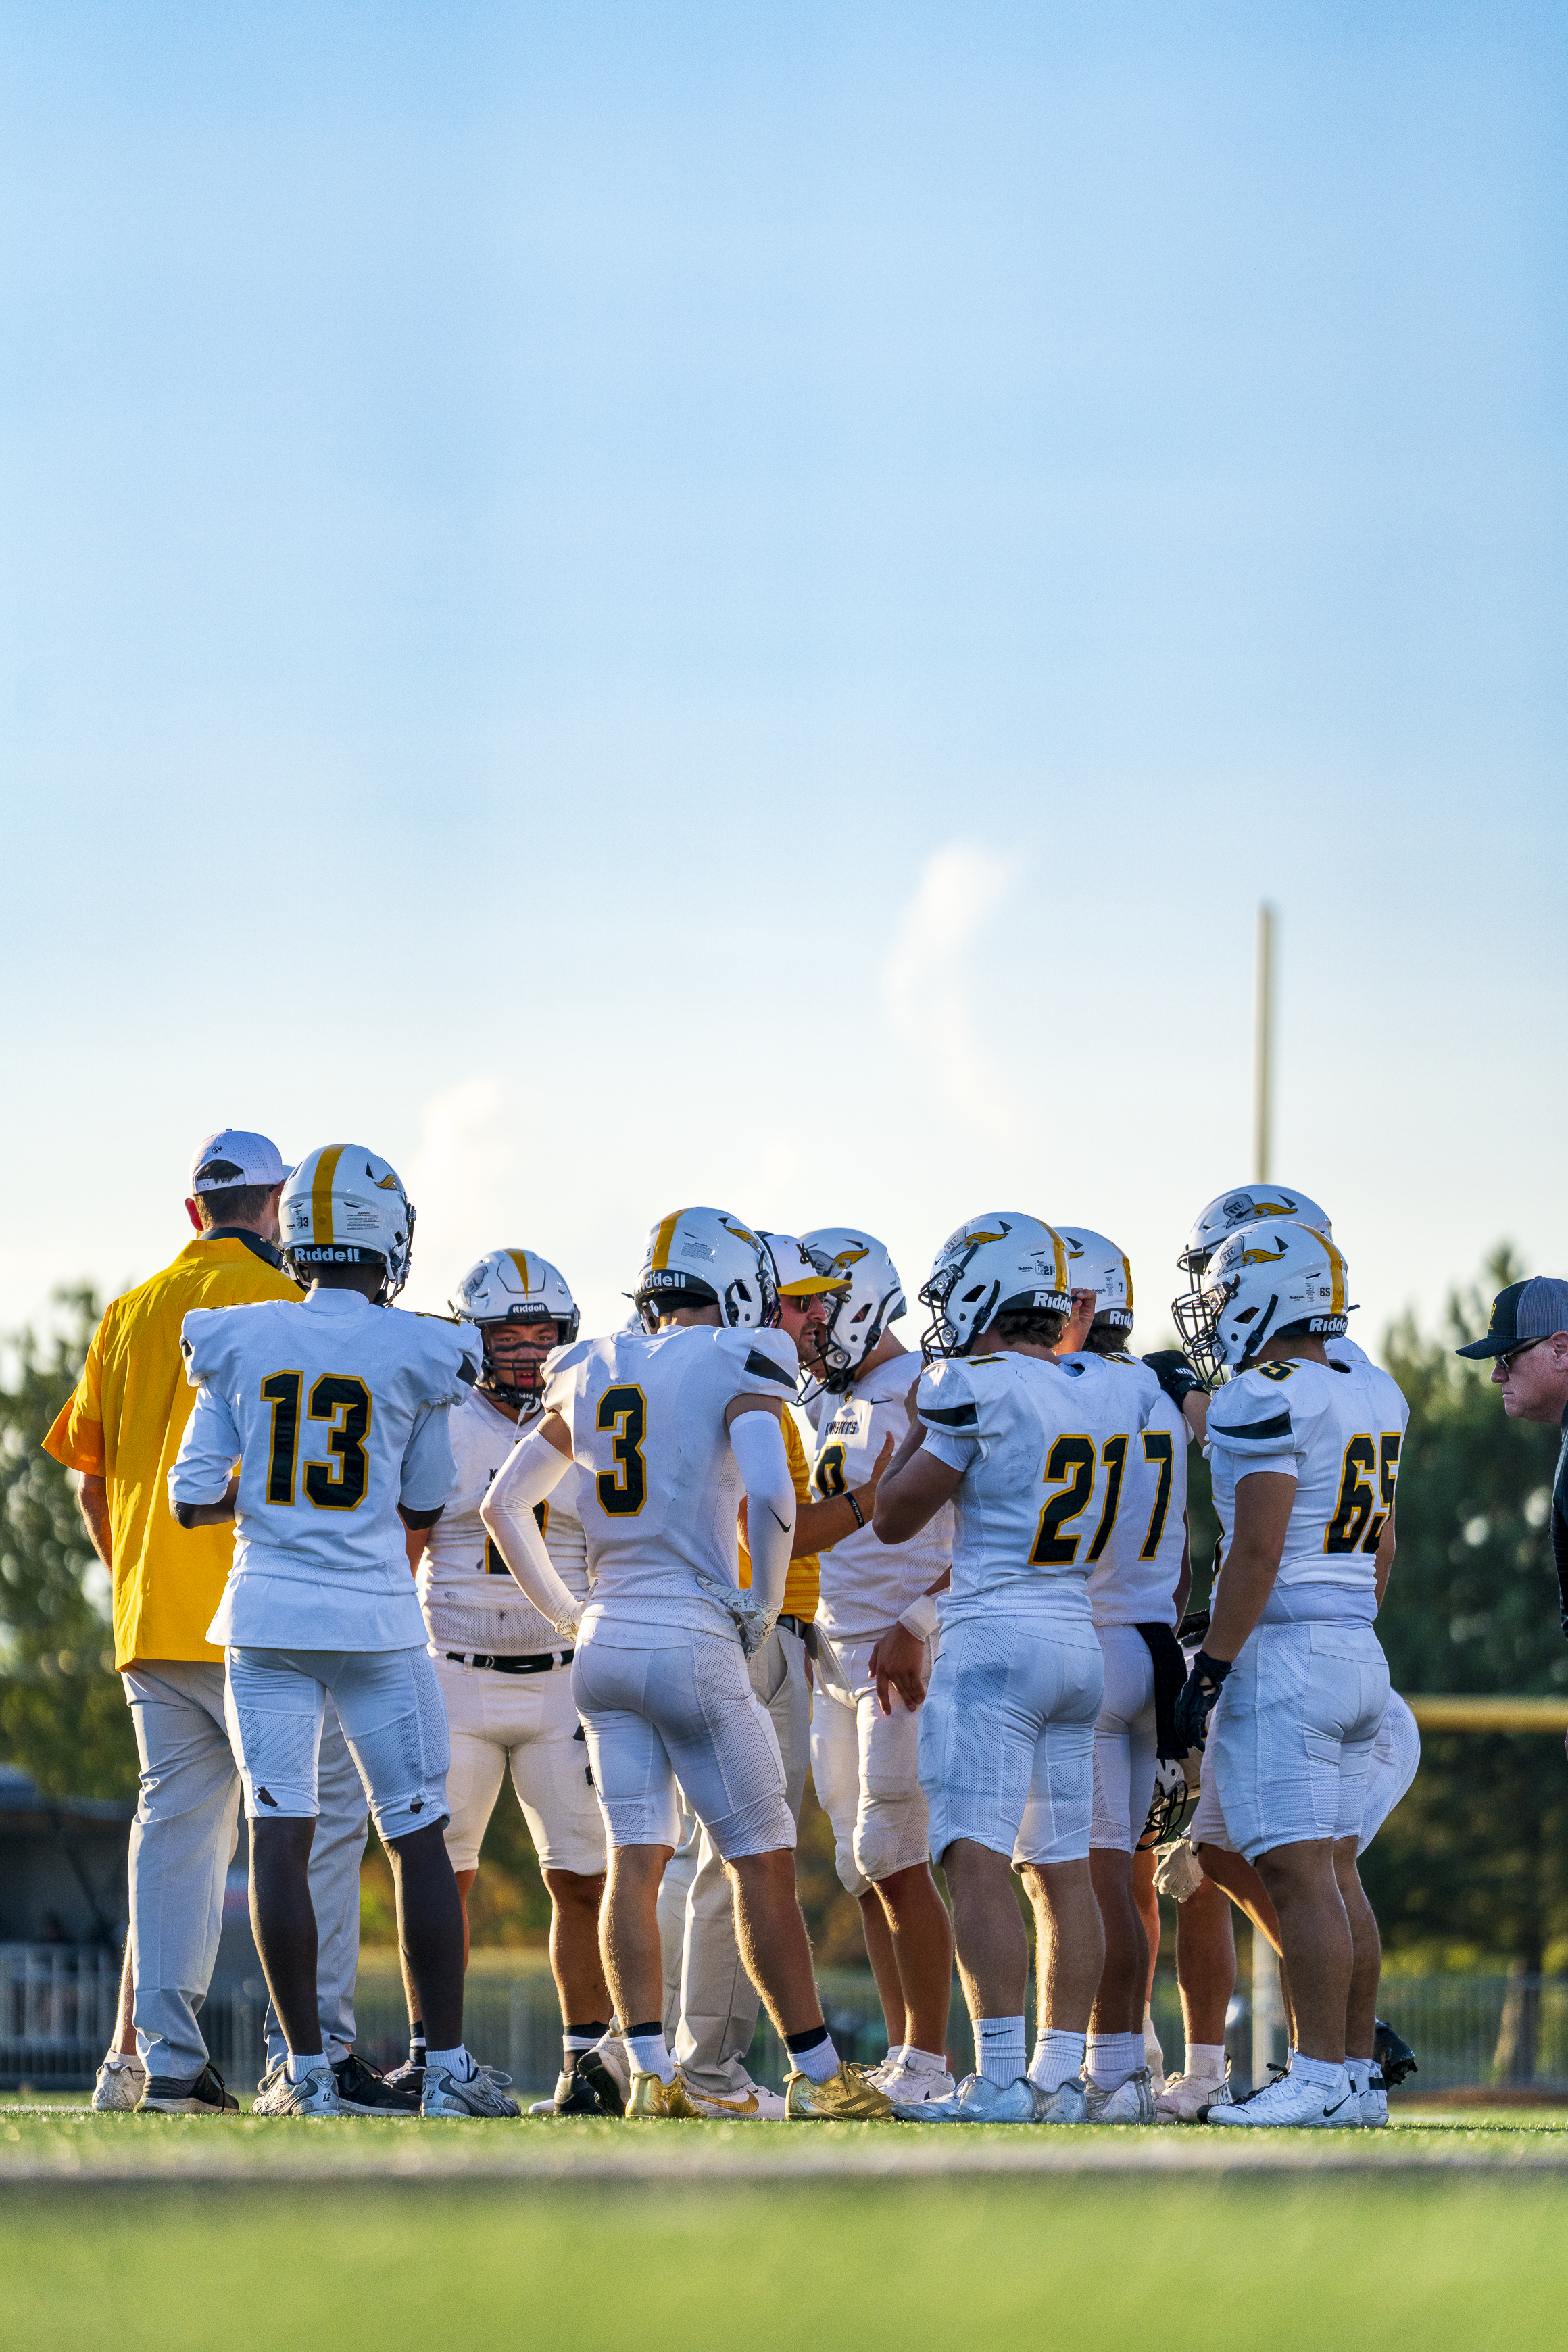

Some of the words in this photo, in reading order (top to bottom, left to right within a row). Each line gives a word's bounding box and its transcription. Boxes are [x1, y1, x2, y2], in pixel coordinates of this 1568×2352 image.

[300, 1217, 309, 1227] 13
[294, 1247, 360, 1263] Riddell
[1044, 1265, 1053, 1275] 21
[1118, 1282, 1124, 1292] 7
[1319, 1287, 1331, 1297] 65
[512, 1304, 545, 1313] Riddell
[1308, 1317, 1348, 1333] Ridde
[825, 1421, 858, 1436] KNIGHTS
[260, 1369, 373, 1512] 13
[595, 1383, 648, 1518] 3
[1027, 1433, 1130, 1567] 21
[1137, 1430, 1175, 1561] 7
[1323, 1431, 1402, 1554] 65
